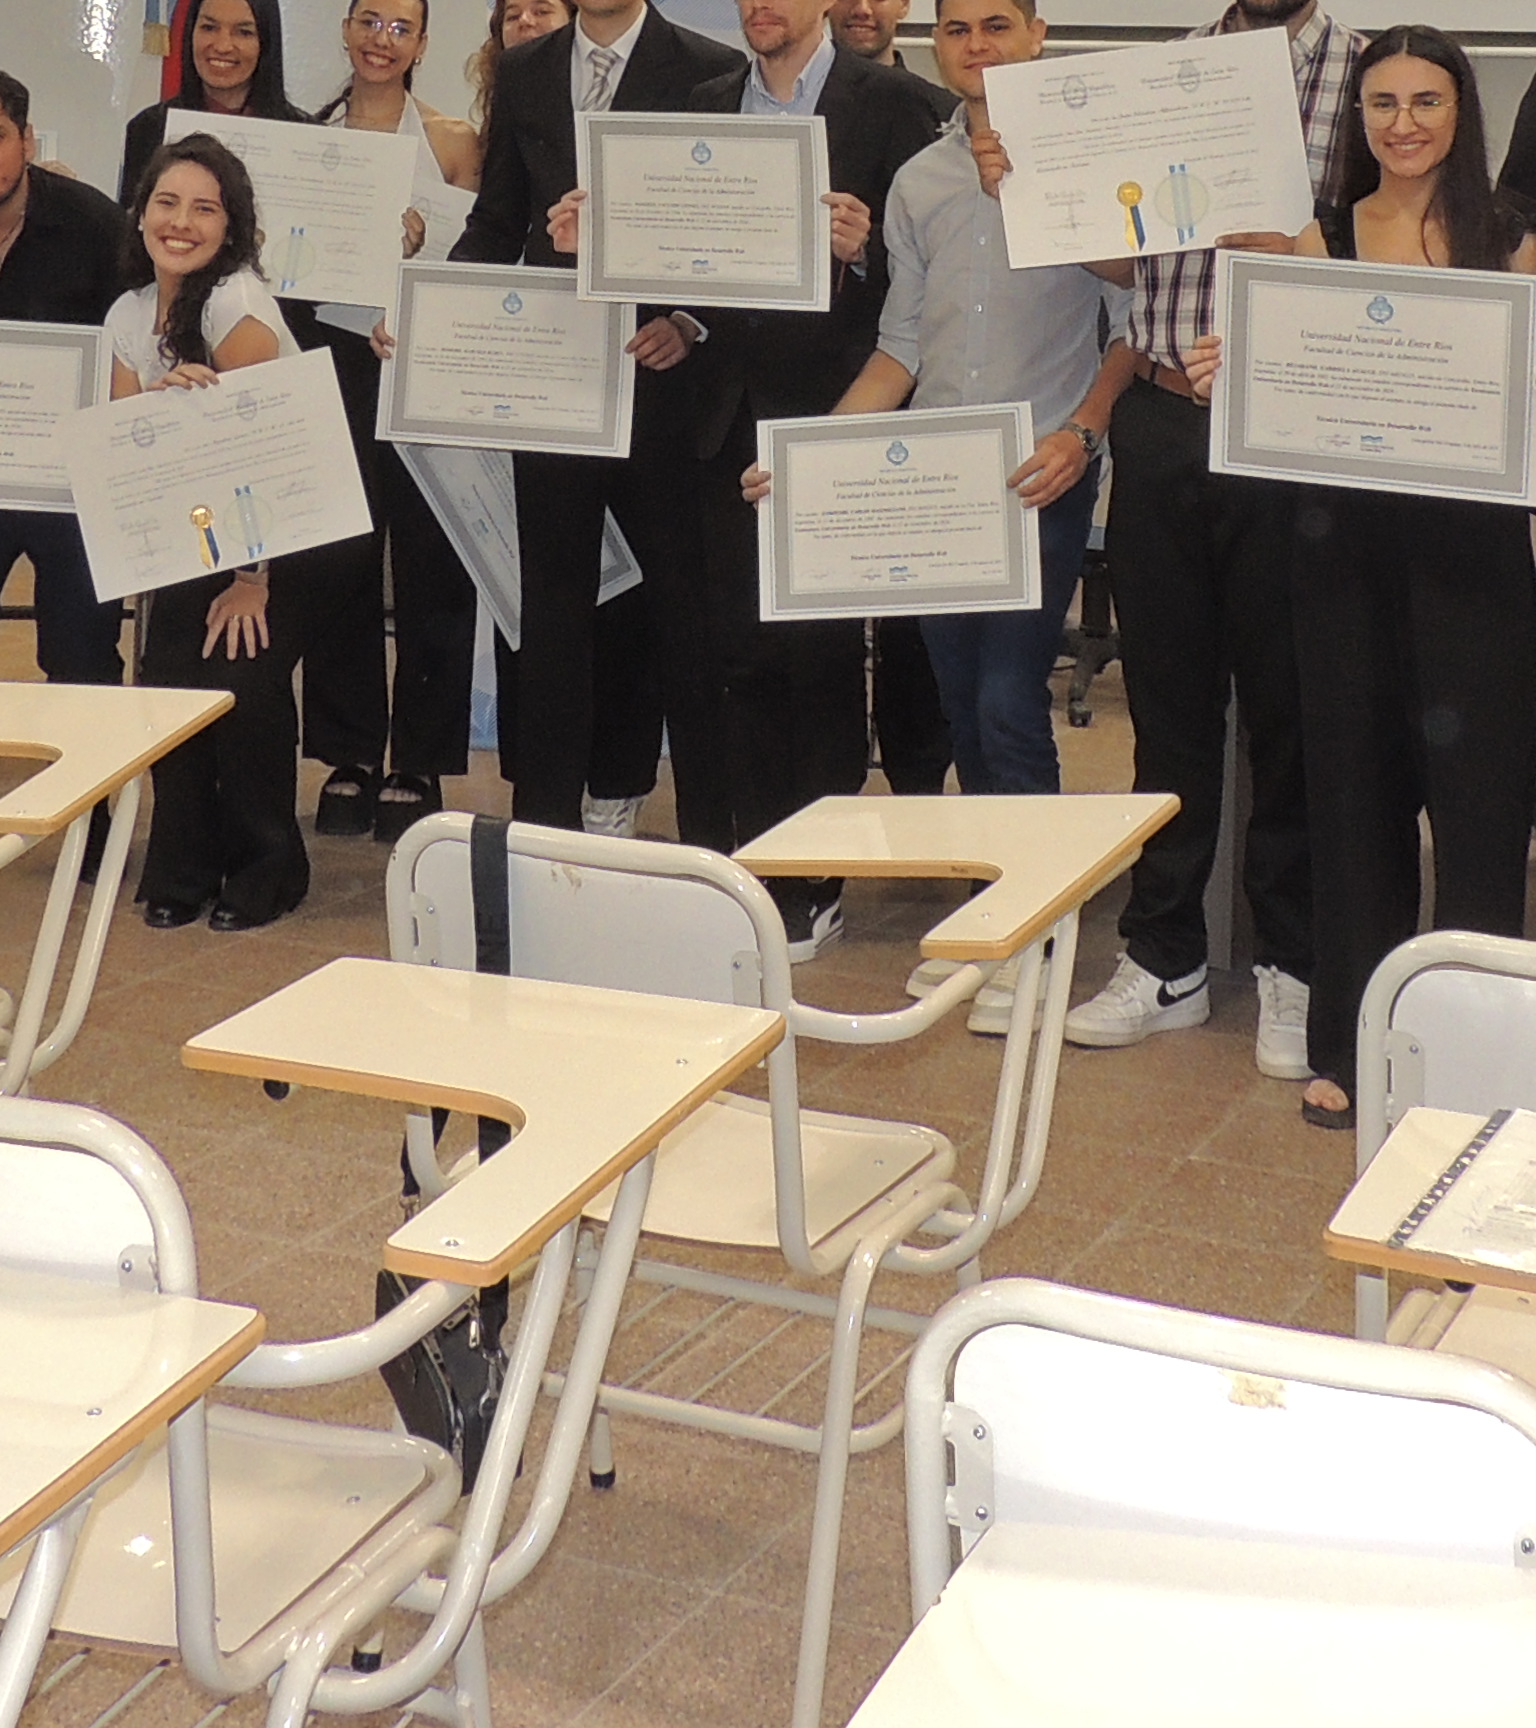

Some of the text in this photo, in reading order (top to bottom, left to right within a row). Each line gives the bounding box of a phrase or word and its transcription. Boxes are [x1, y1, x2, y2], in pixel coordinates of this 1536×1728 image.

[1300, 330, 1352, 343] Universidad
[1354, 335, 1393, 347] Nacional
[1394, 338, 1405, 348] de
[1407, 339, 1431, 350] Entre
[832, 478, 875, 488] Universidad
[877, 476, 909, 486] Nacional
[910, 475, 919, 484] de
[921, 474, 940, 483] Entre
